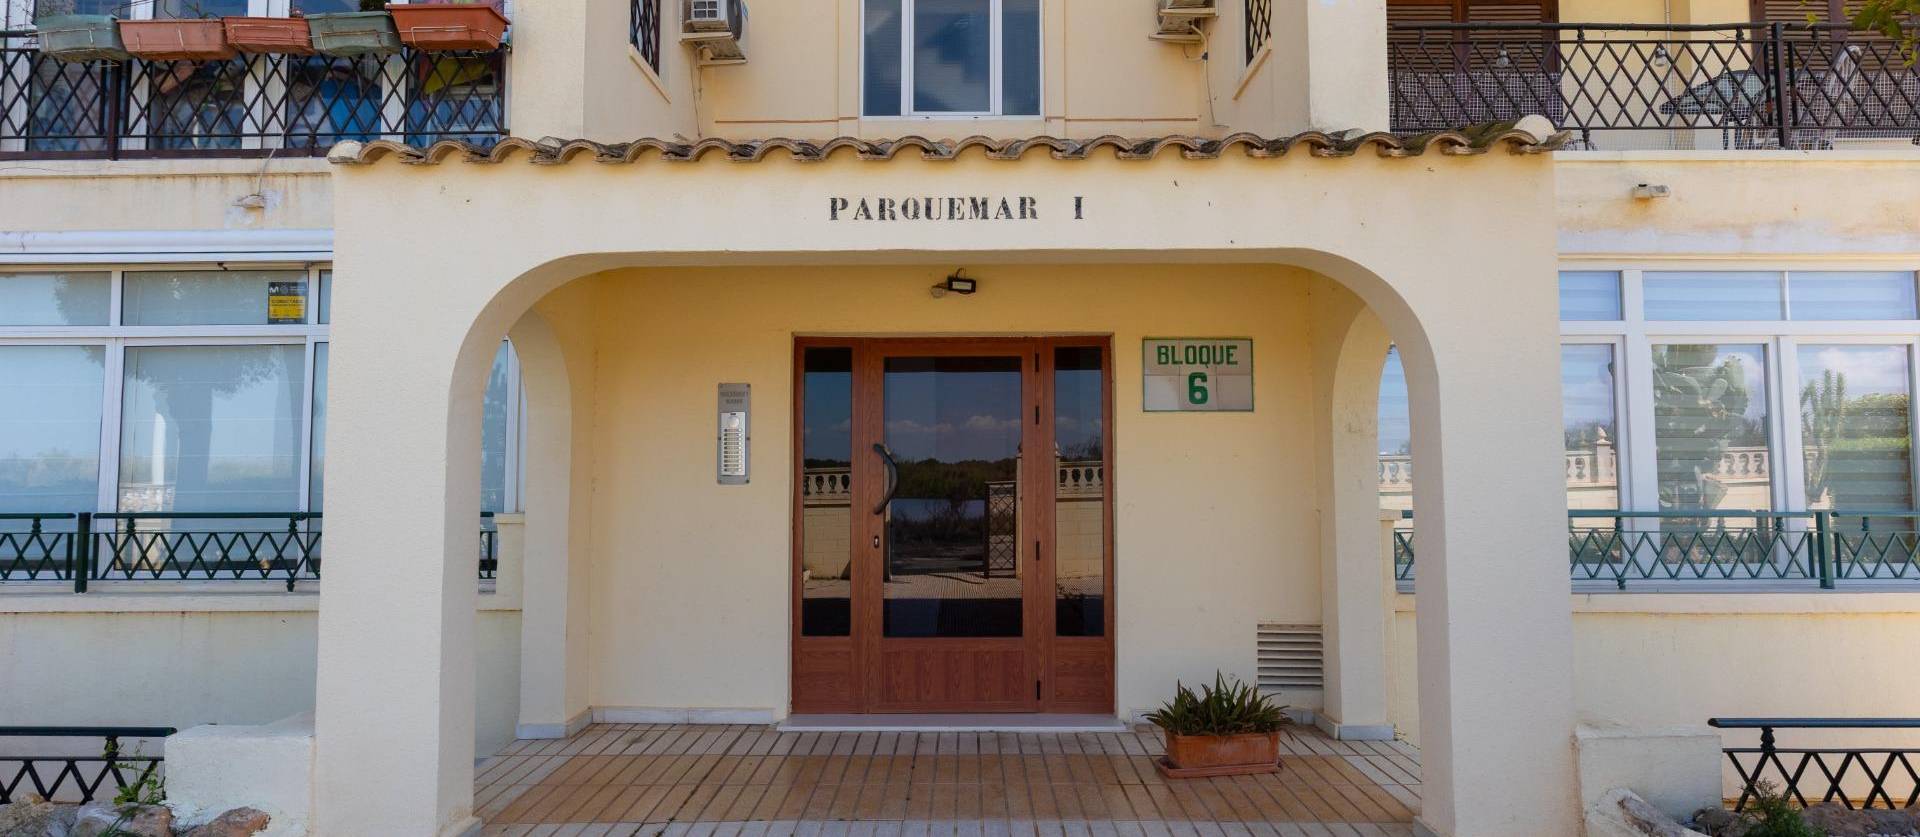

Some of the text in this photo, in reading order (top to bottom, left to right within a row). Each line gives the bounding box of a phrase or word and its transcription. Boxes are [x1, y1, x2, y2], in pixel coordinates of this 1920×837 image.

[829, 196, 1085, 221] PARQUEMAR I
[1157, 345, 1239, 369] BLOQUE
[1188, 371, 1209, 405] 6
